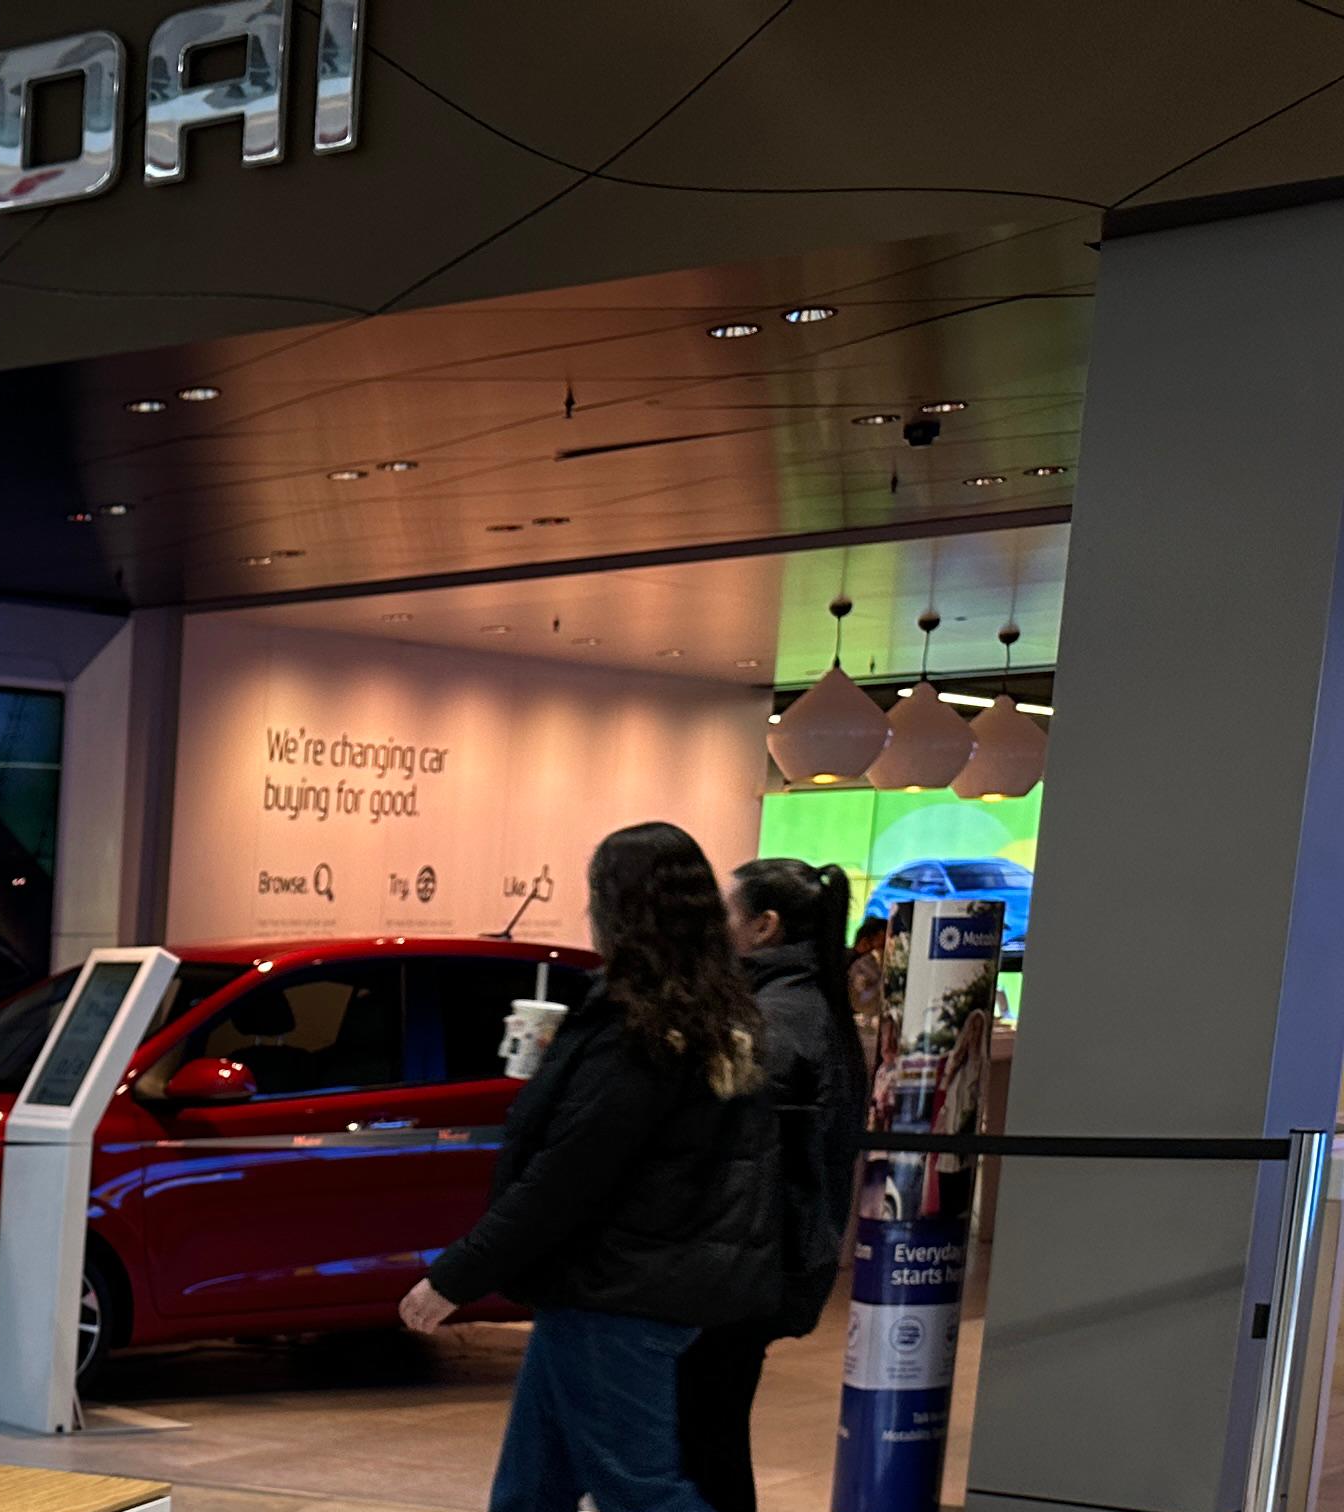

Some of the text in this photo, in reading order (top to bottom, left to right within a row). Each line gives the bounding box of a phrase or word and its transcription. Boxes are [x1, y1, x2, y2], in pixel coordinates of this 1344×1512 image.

[266, 727, 448, 779] We're changing car
[264, 776, 420, 824] buying for good.
[890, 1267, 943, 1286] starts
